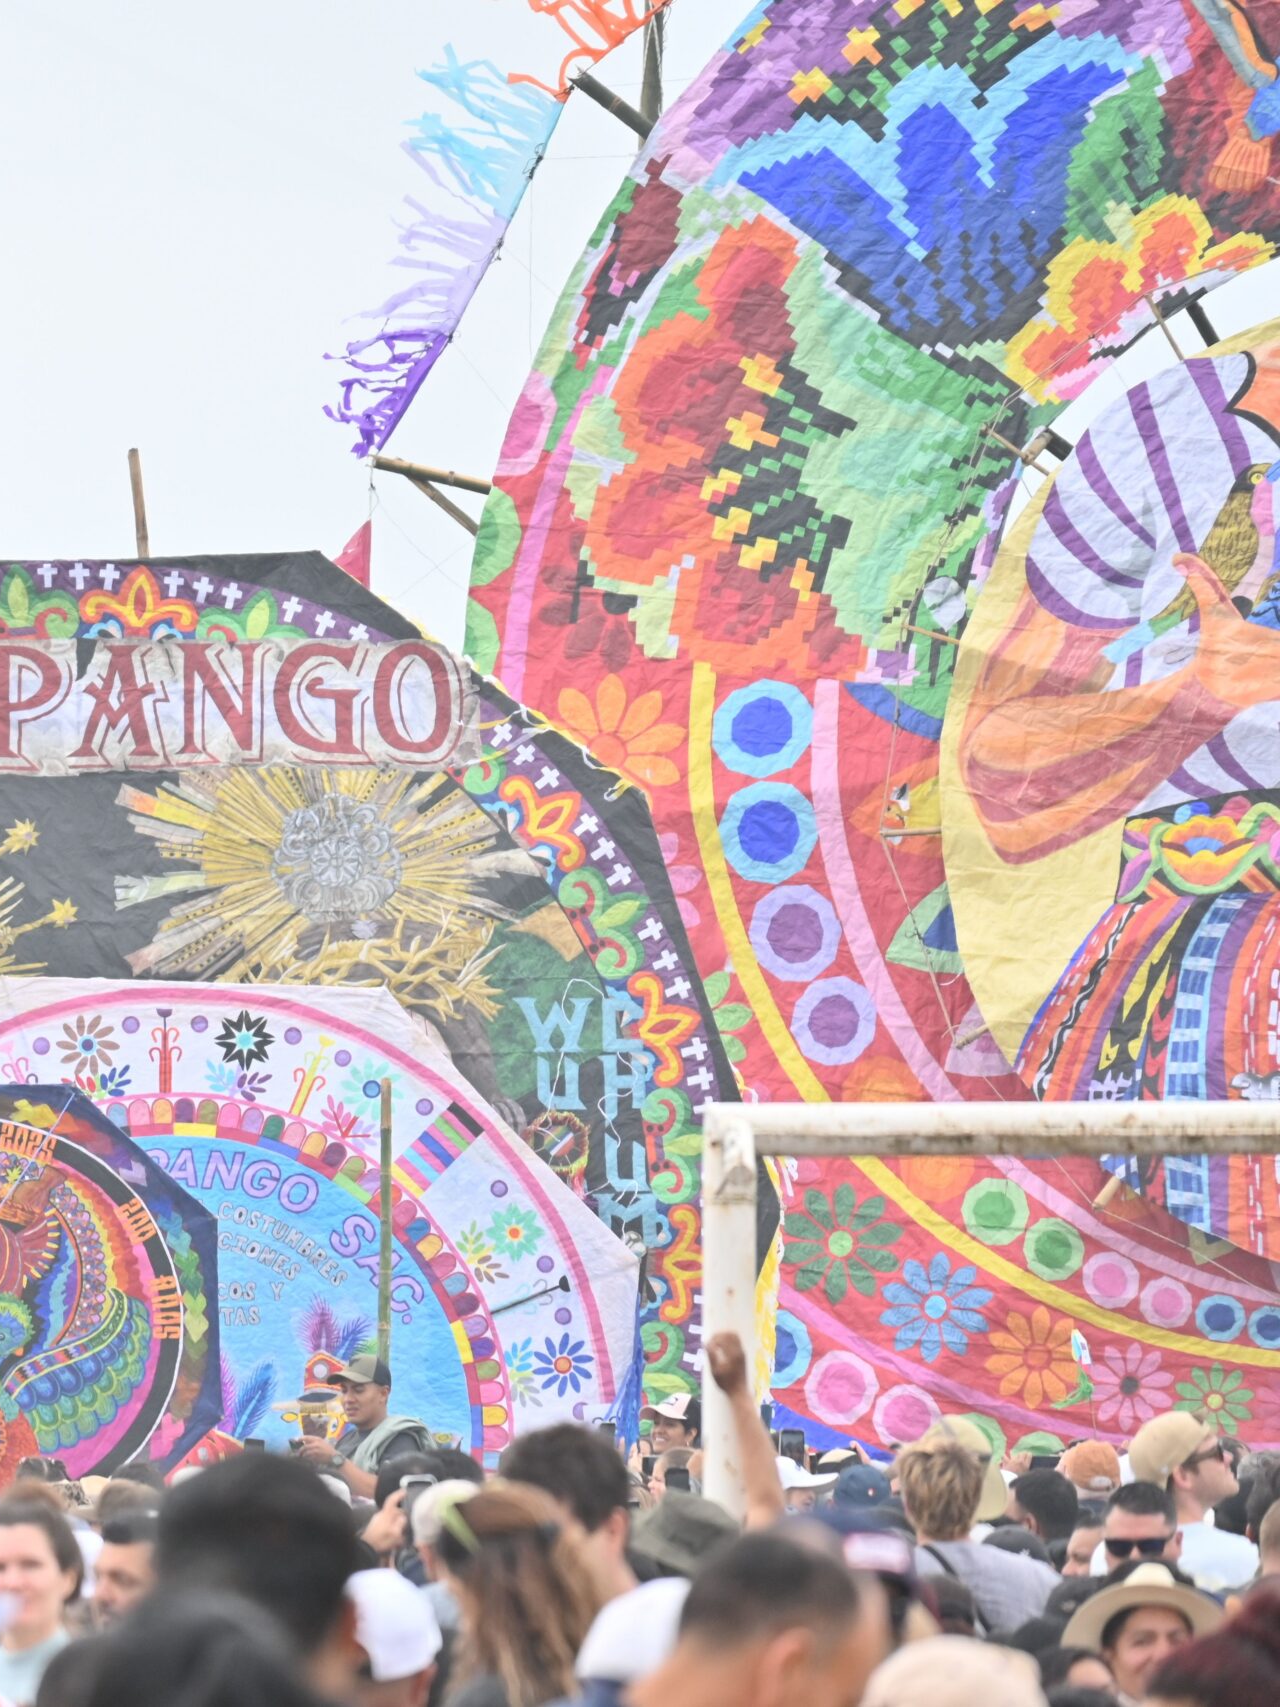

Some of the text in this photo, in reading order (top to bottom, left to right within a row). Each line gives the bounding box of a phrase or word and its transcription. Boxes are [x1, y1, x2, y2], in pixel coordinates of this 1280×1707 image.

[0, 1122, 58, 1166] 2025
[218, 1201, 348, 1287] COSTUMBRES
[328, 1213, 425, 1325] SAC.
[270, 1281, 286, 1301] Y
